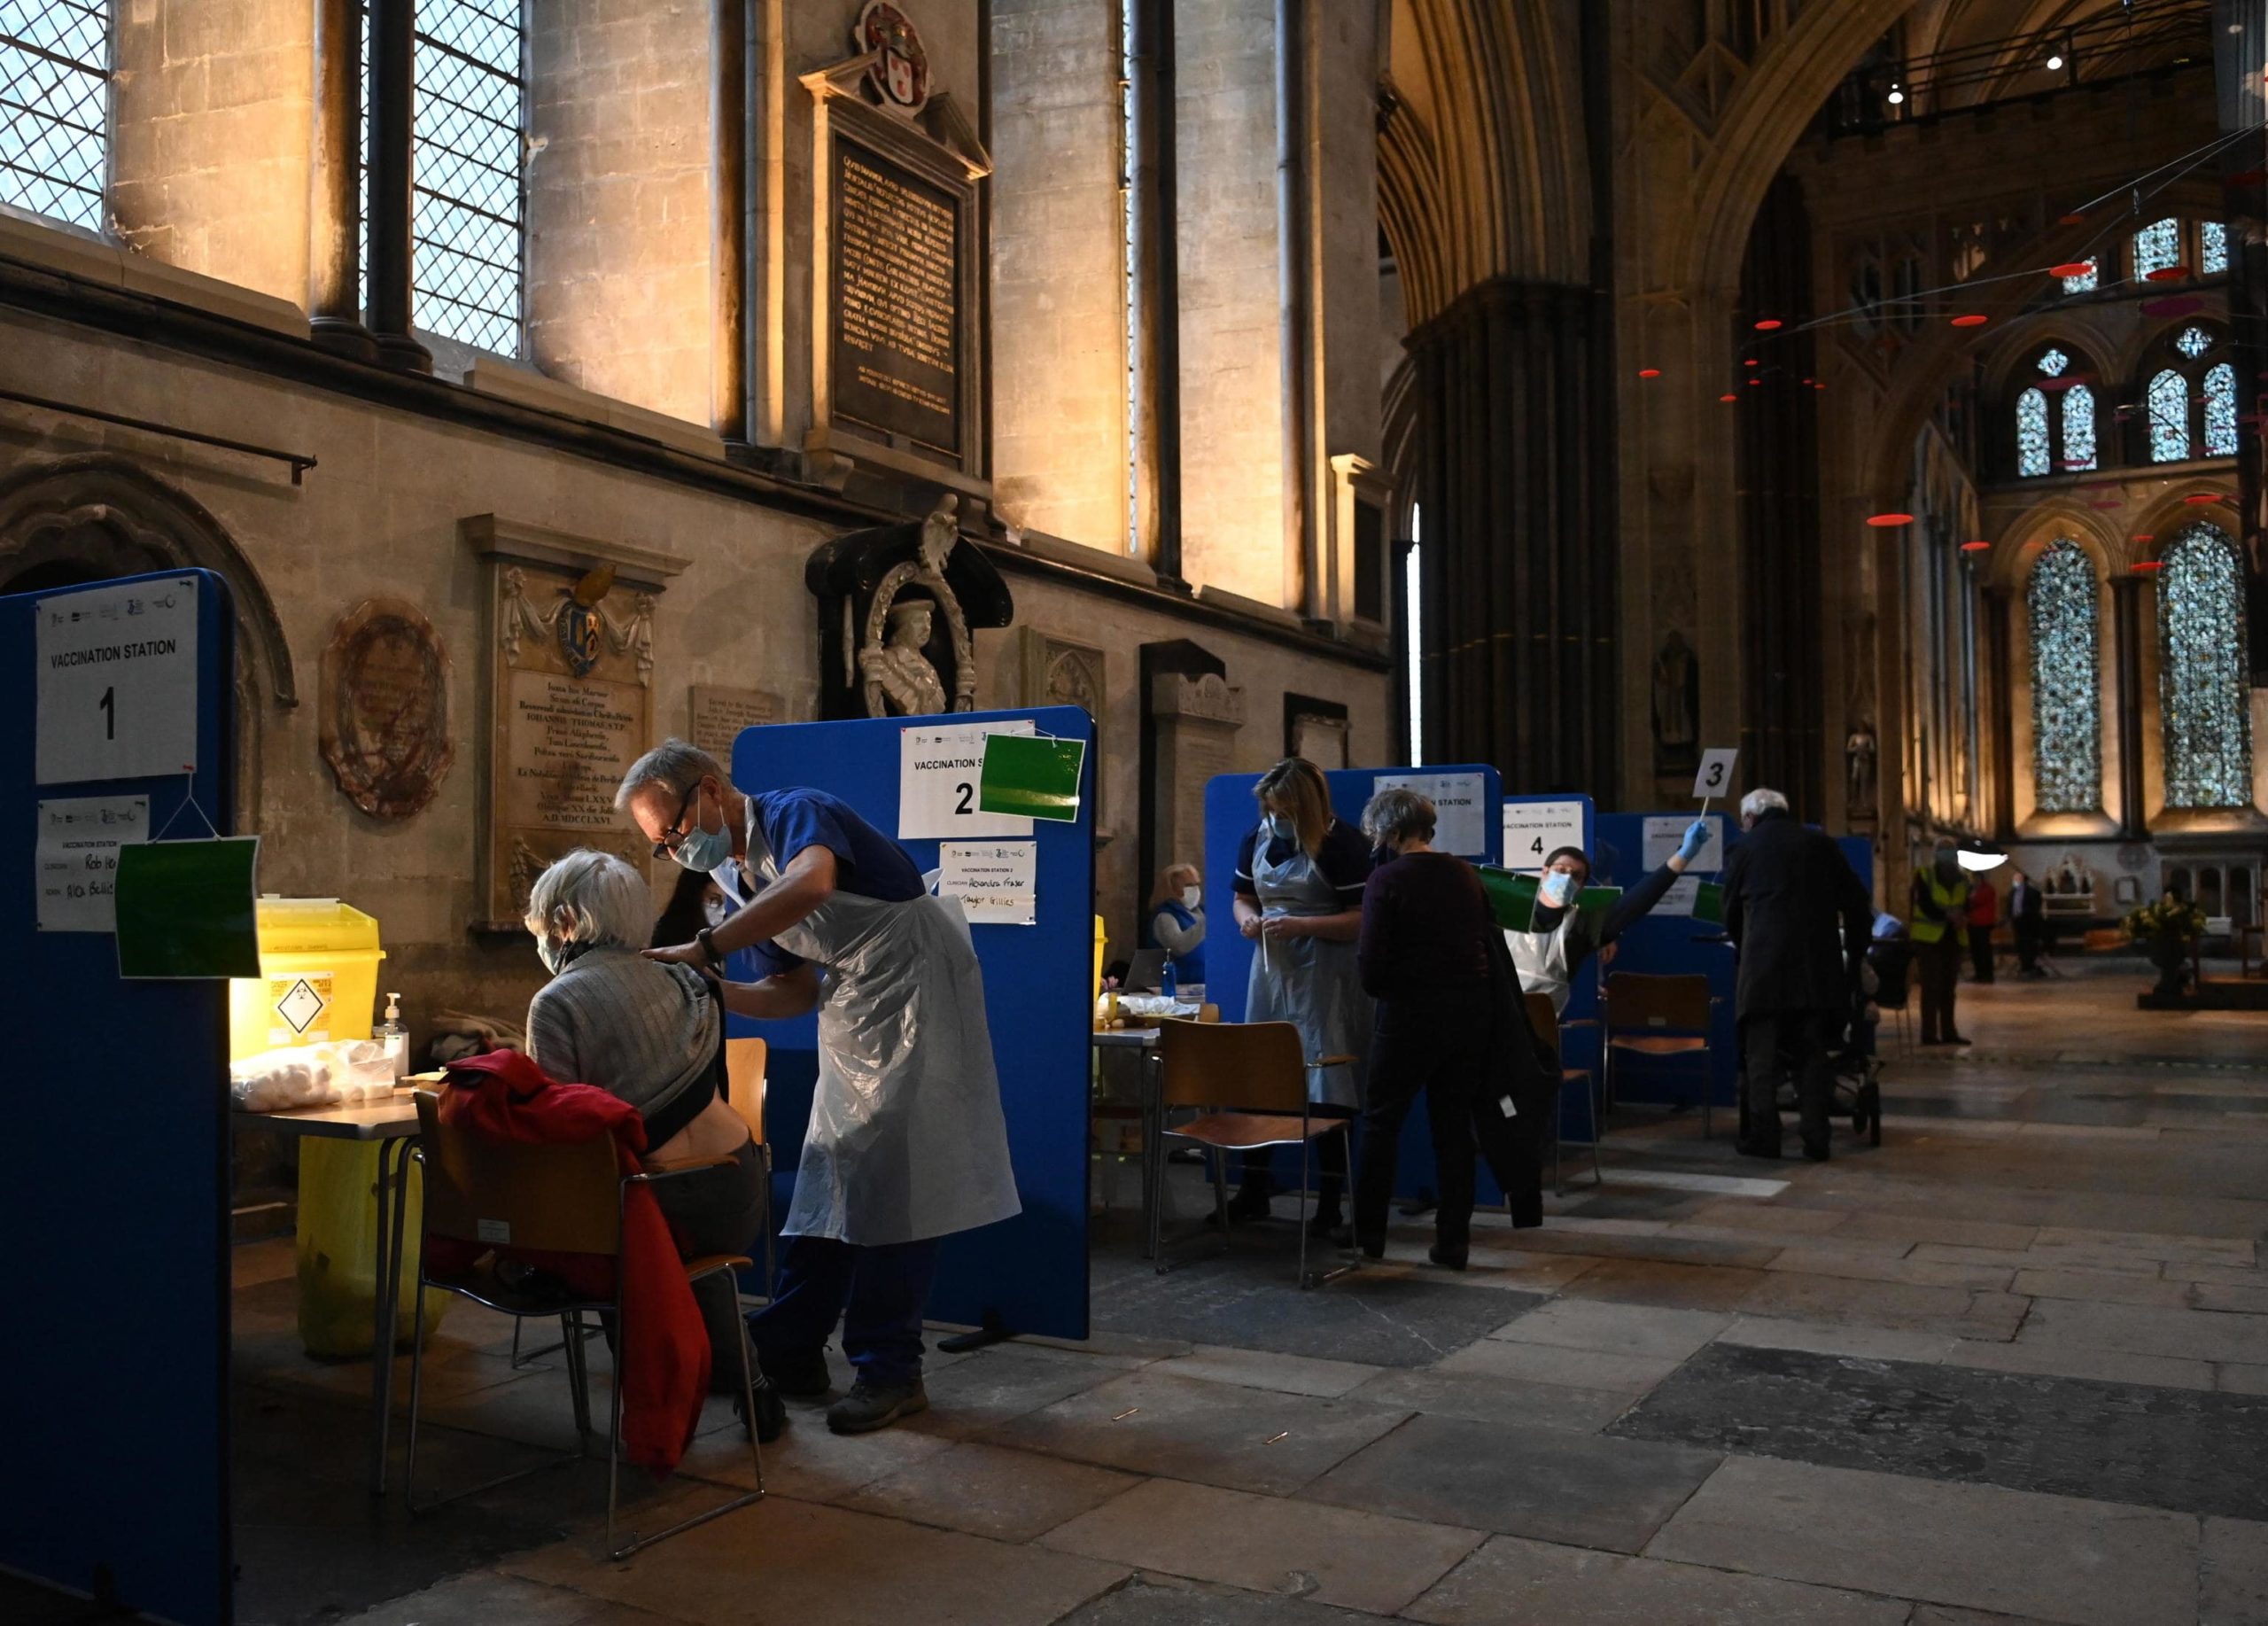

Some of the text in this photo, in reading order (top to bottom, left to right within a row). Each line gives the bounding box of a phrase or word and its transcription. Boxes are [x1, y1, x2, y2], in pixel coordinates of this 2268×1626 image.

[51, 639, 176, 668] VACCINATION STATION
[99, 686, 114, 740] 1
[914, 759, 975, 770] VACCINATION
[1705, 762, 1723, 787] 3
[954, 782, 973, 814] 2
[1438, 798, 1472, 807] STATION
[1530, 837, 1543, 855] 4
